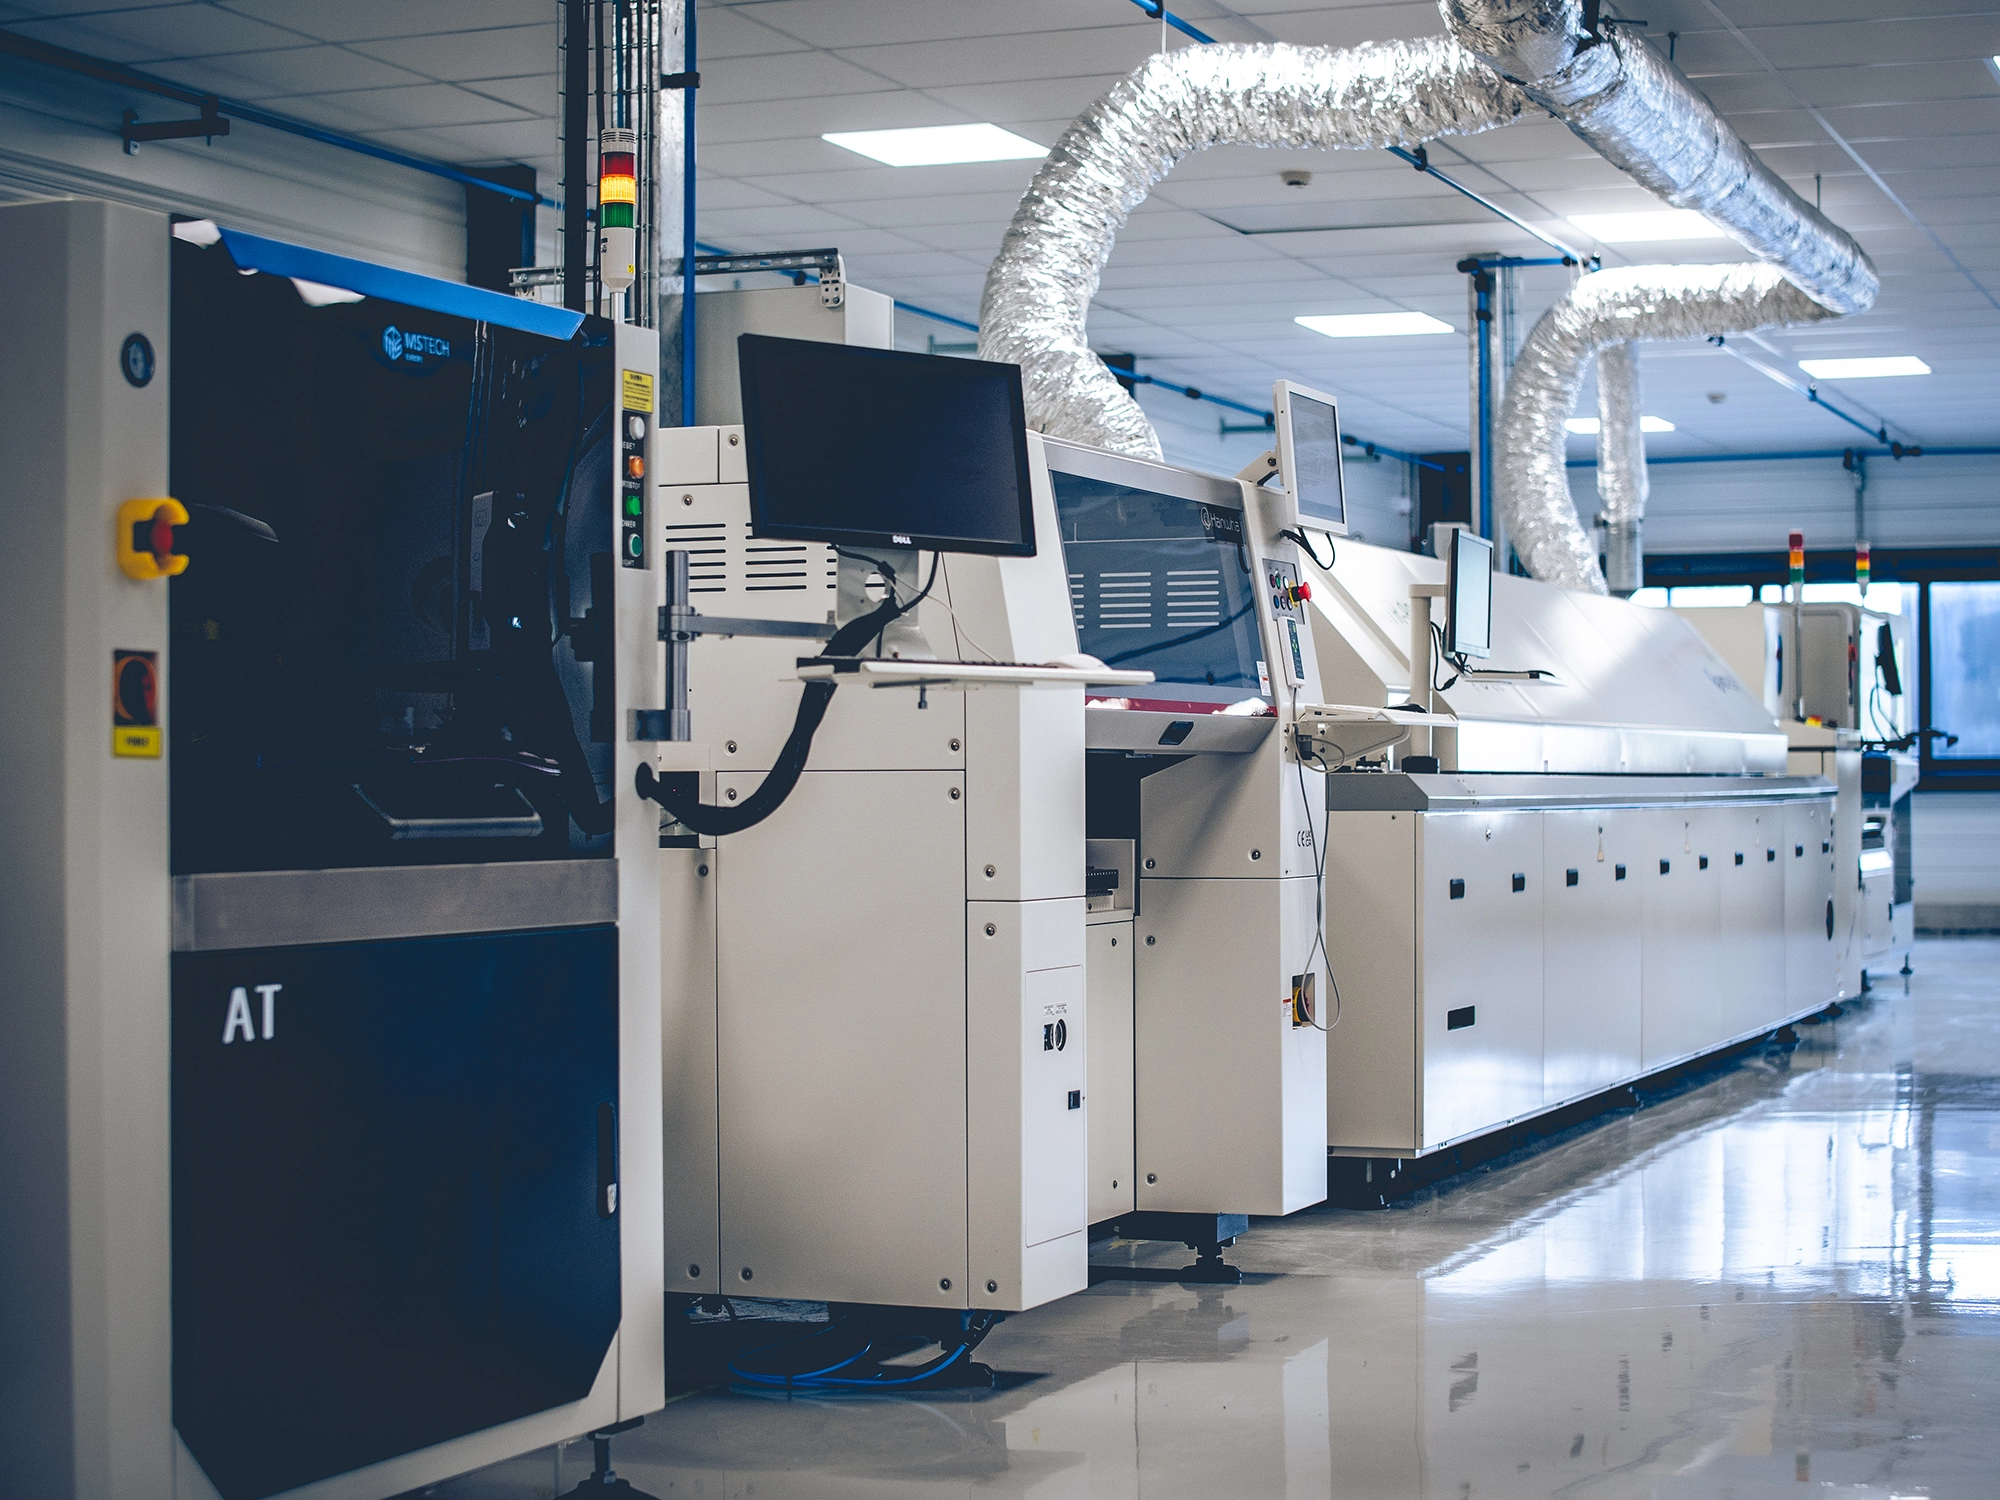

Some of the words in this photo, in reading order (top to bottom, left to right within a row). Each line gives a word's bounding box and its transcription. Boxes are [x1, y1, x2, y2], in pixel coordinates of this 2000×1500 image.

[403, 331, 450, 358] MSTECH
[1209, 512, 1241, 533] Hanwha
[892, 534, 912, 545] DELL
[221, 984, 283, 1045] AT
